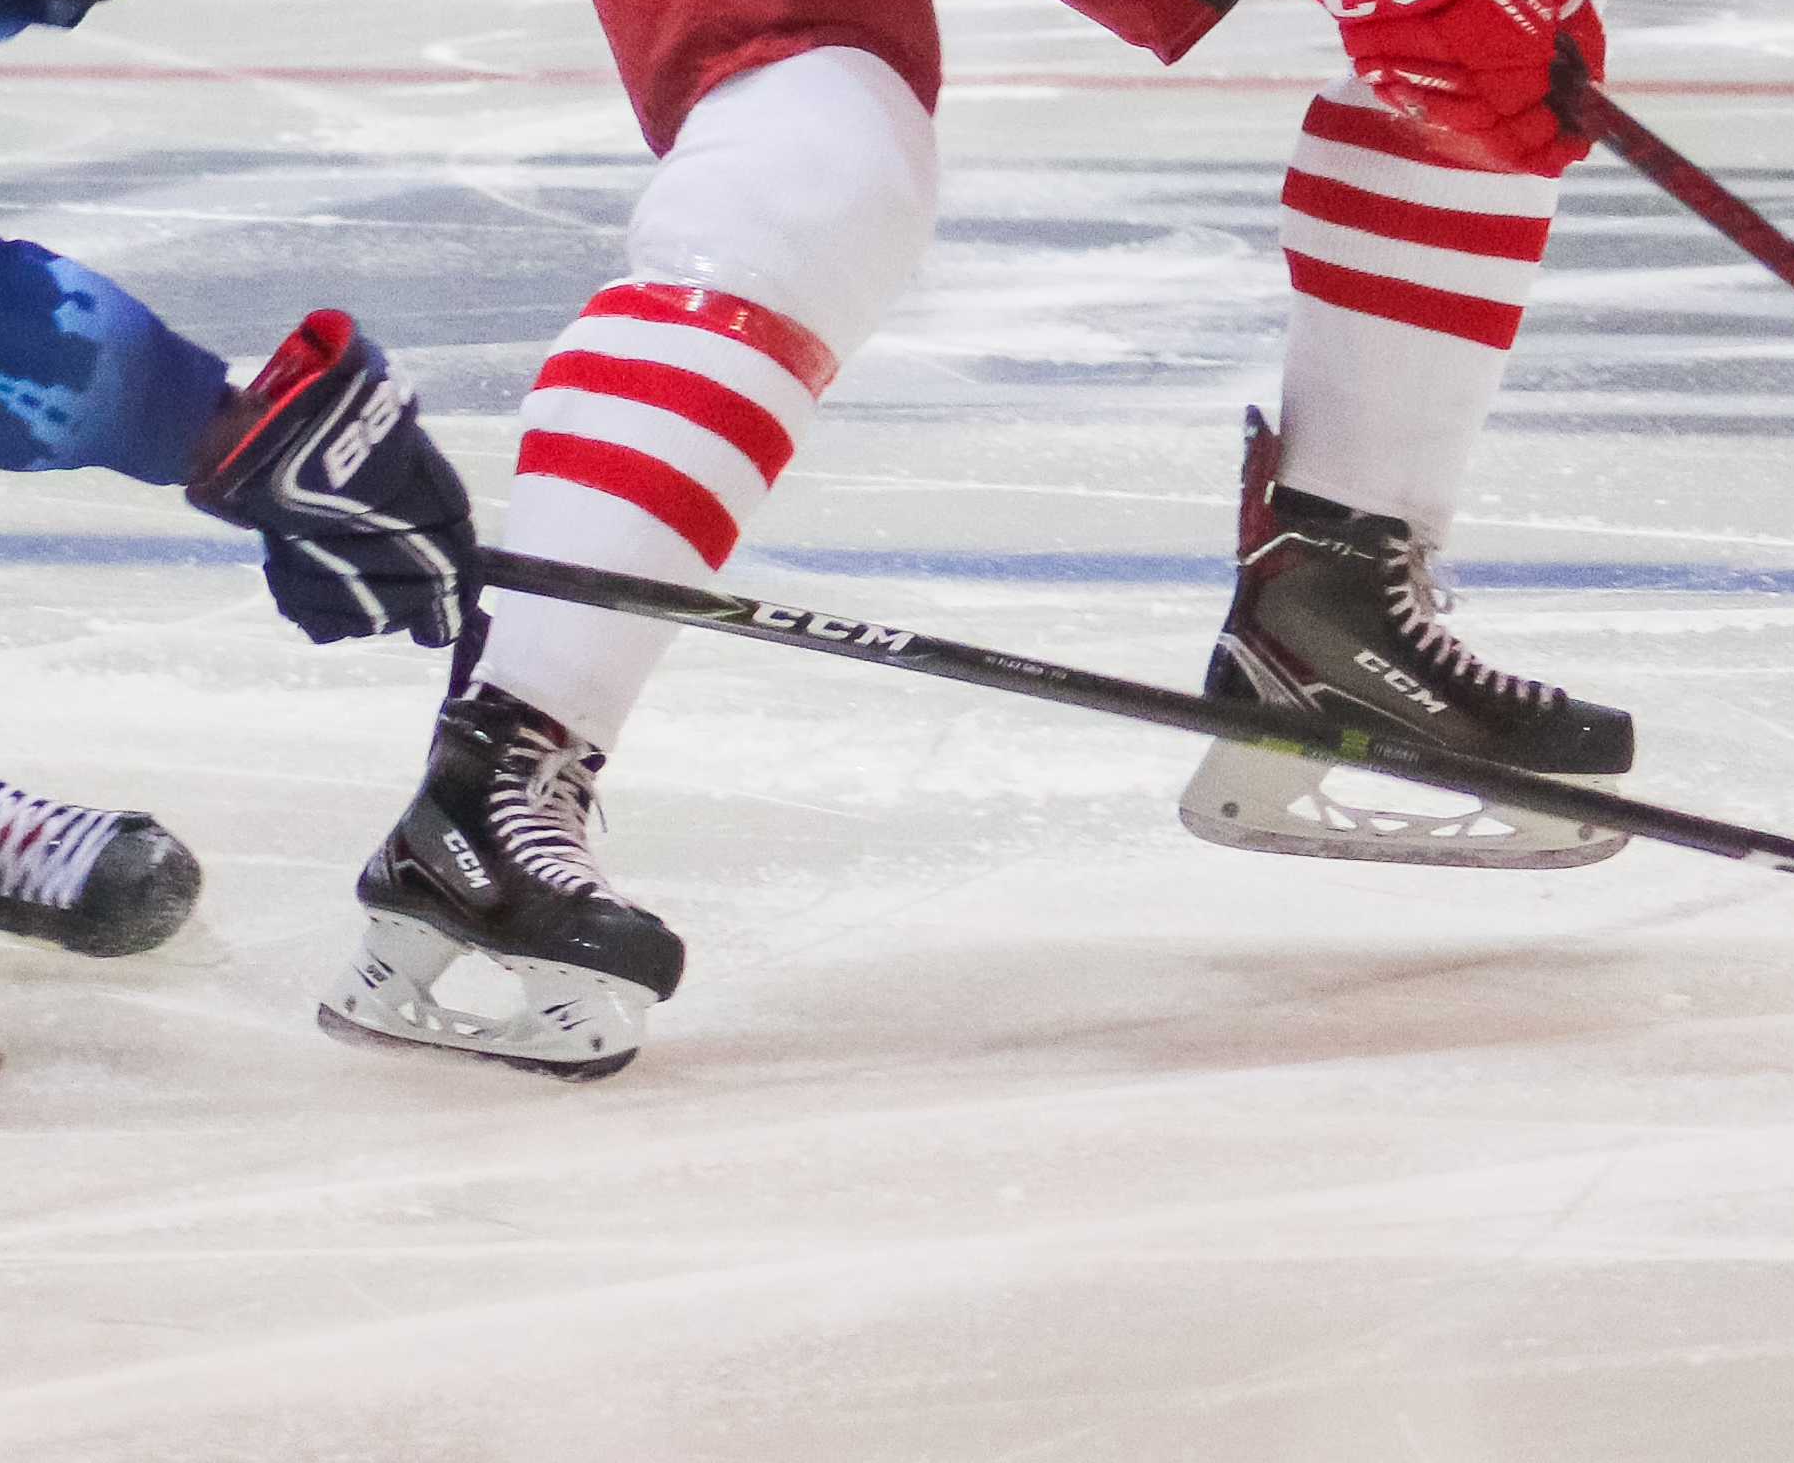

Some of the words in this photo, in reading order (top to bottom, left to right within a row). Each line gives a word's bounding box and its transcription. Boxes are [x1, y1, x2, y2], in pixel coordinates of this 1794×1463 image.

[750, 599, 916, 656] CCM
[1353, 648, 1448, 716] CCM
[441, 828, 492, 890] CCM
